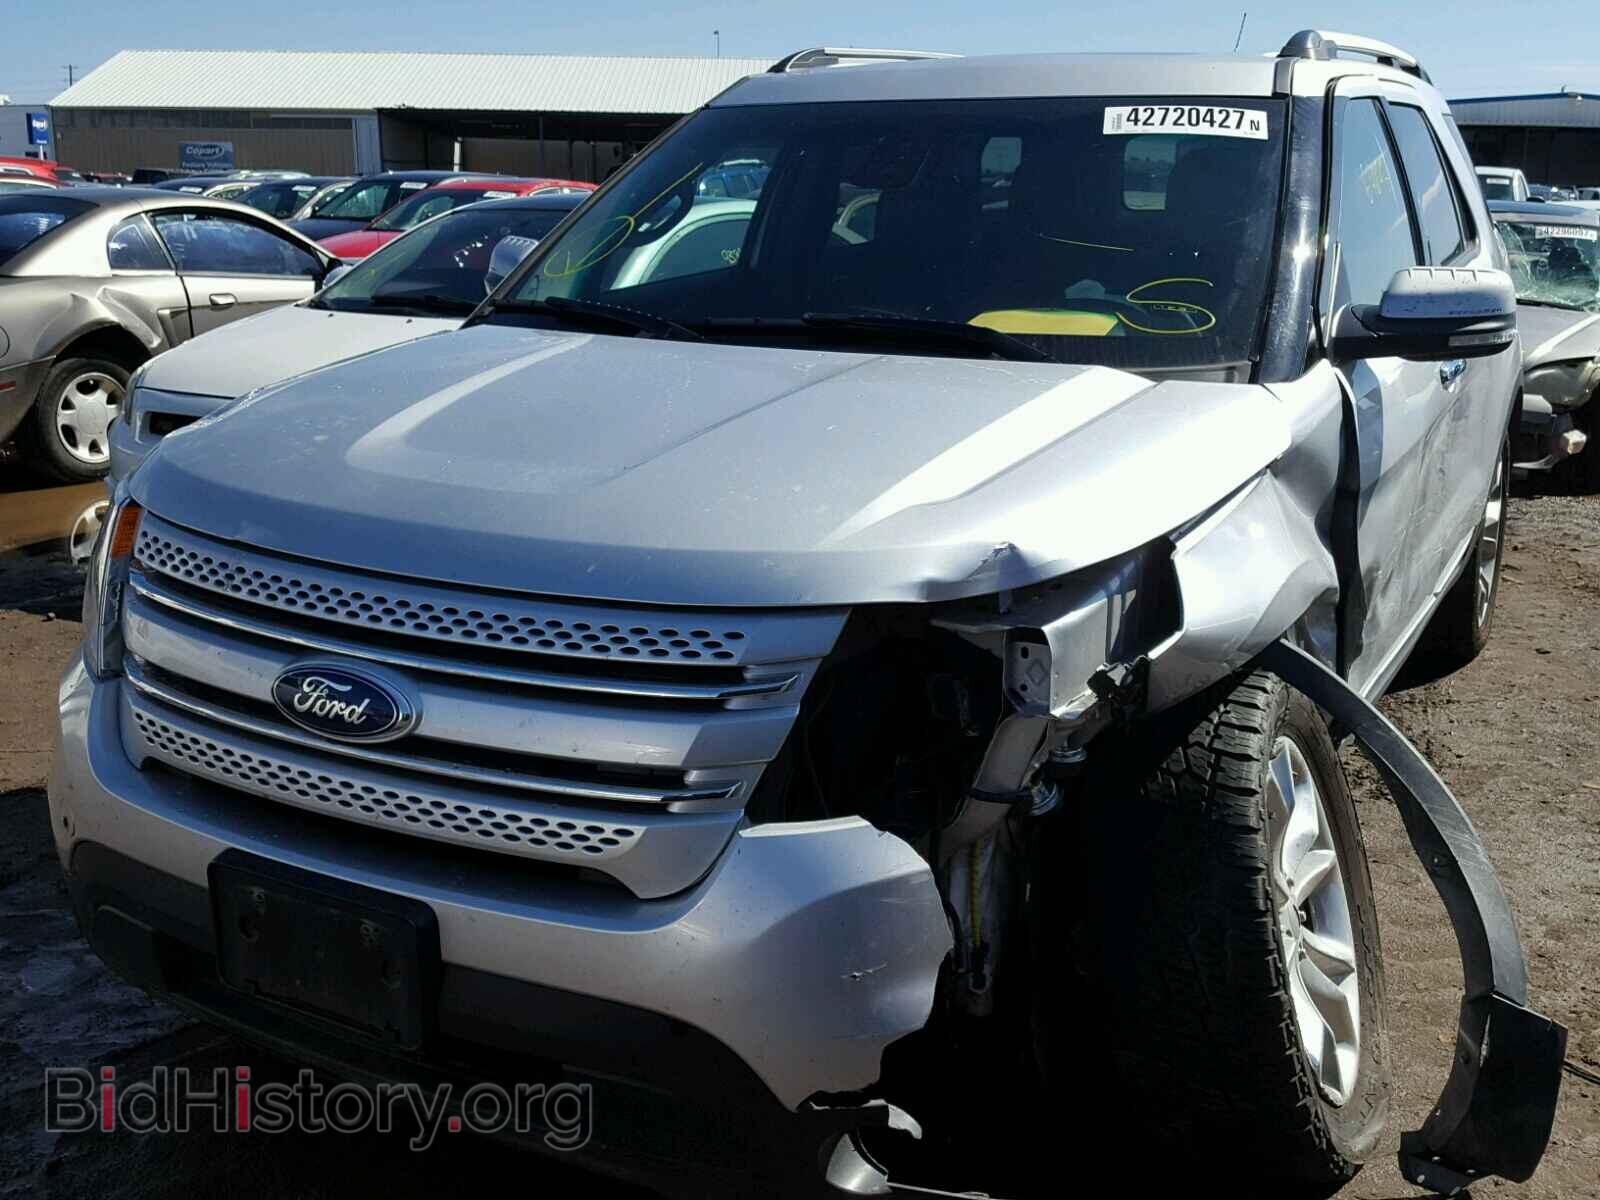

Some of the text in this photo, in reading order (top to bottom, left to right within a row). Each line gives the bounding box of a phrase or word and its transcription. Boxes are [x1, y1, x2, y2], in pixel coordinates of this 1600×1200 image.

[1126, 107, 1245, 130] 42720427
[1250, 119, 1260, 132] N
[293, 676, 371, 725] Ford
